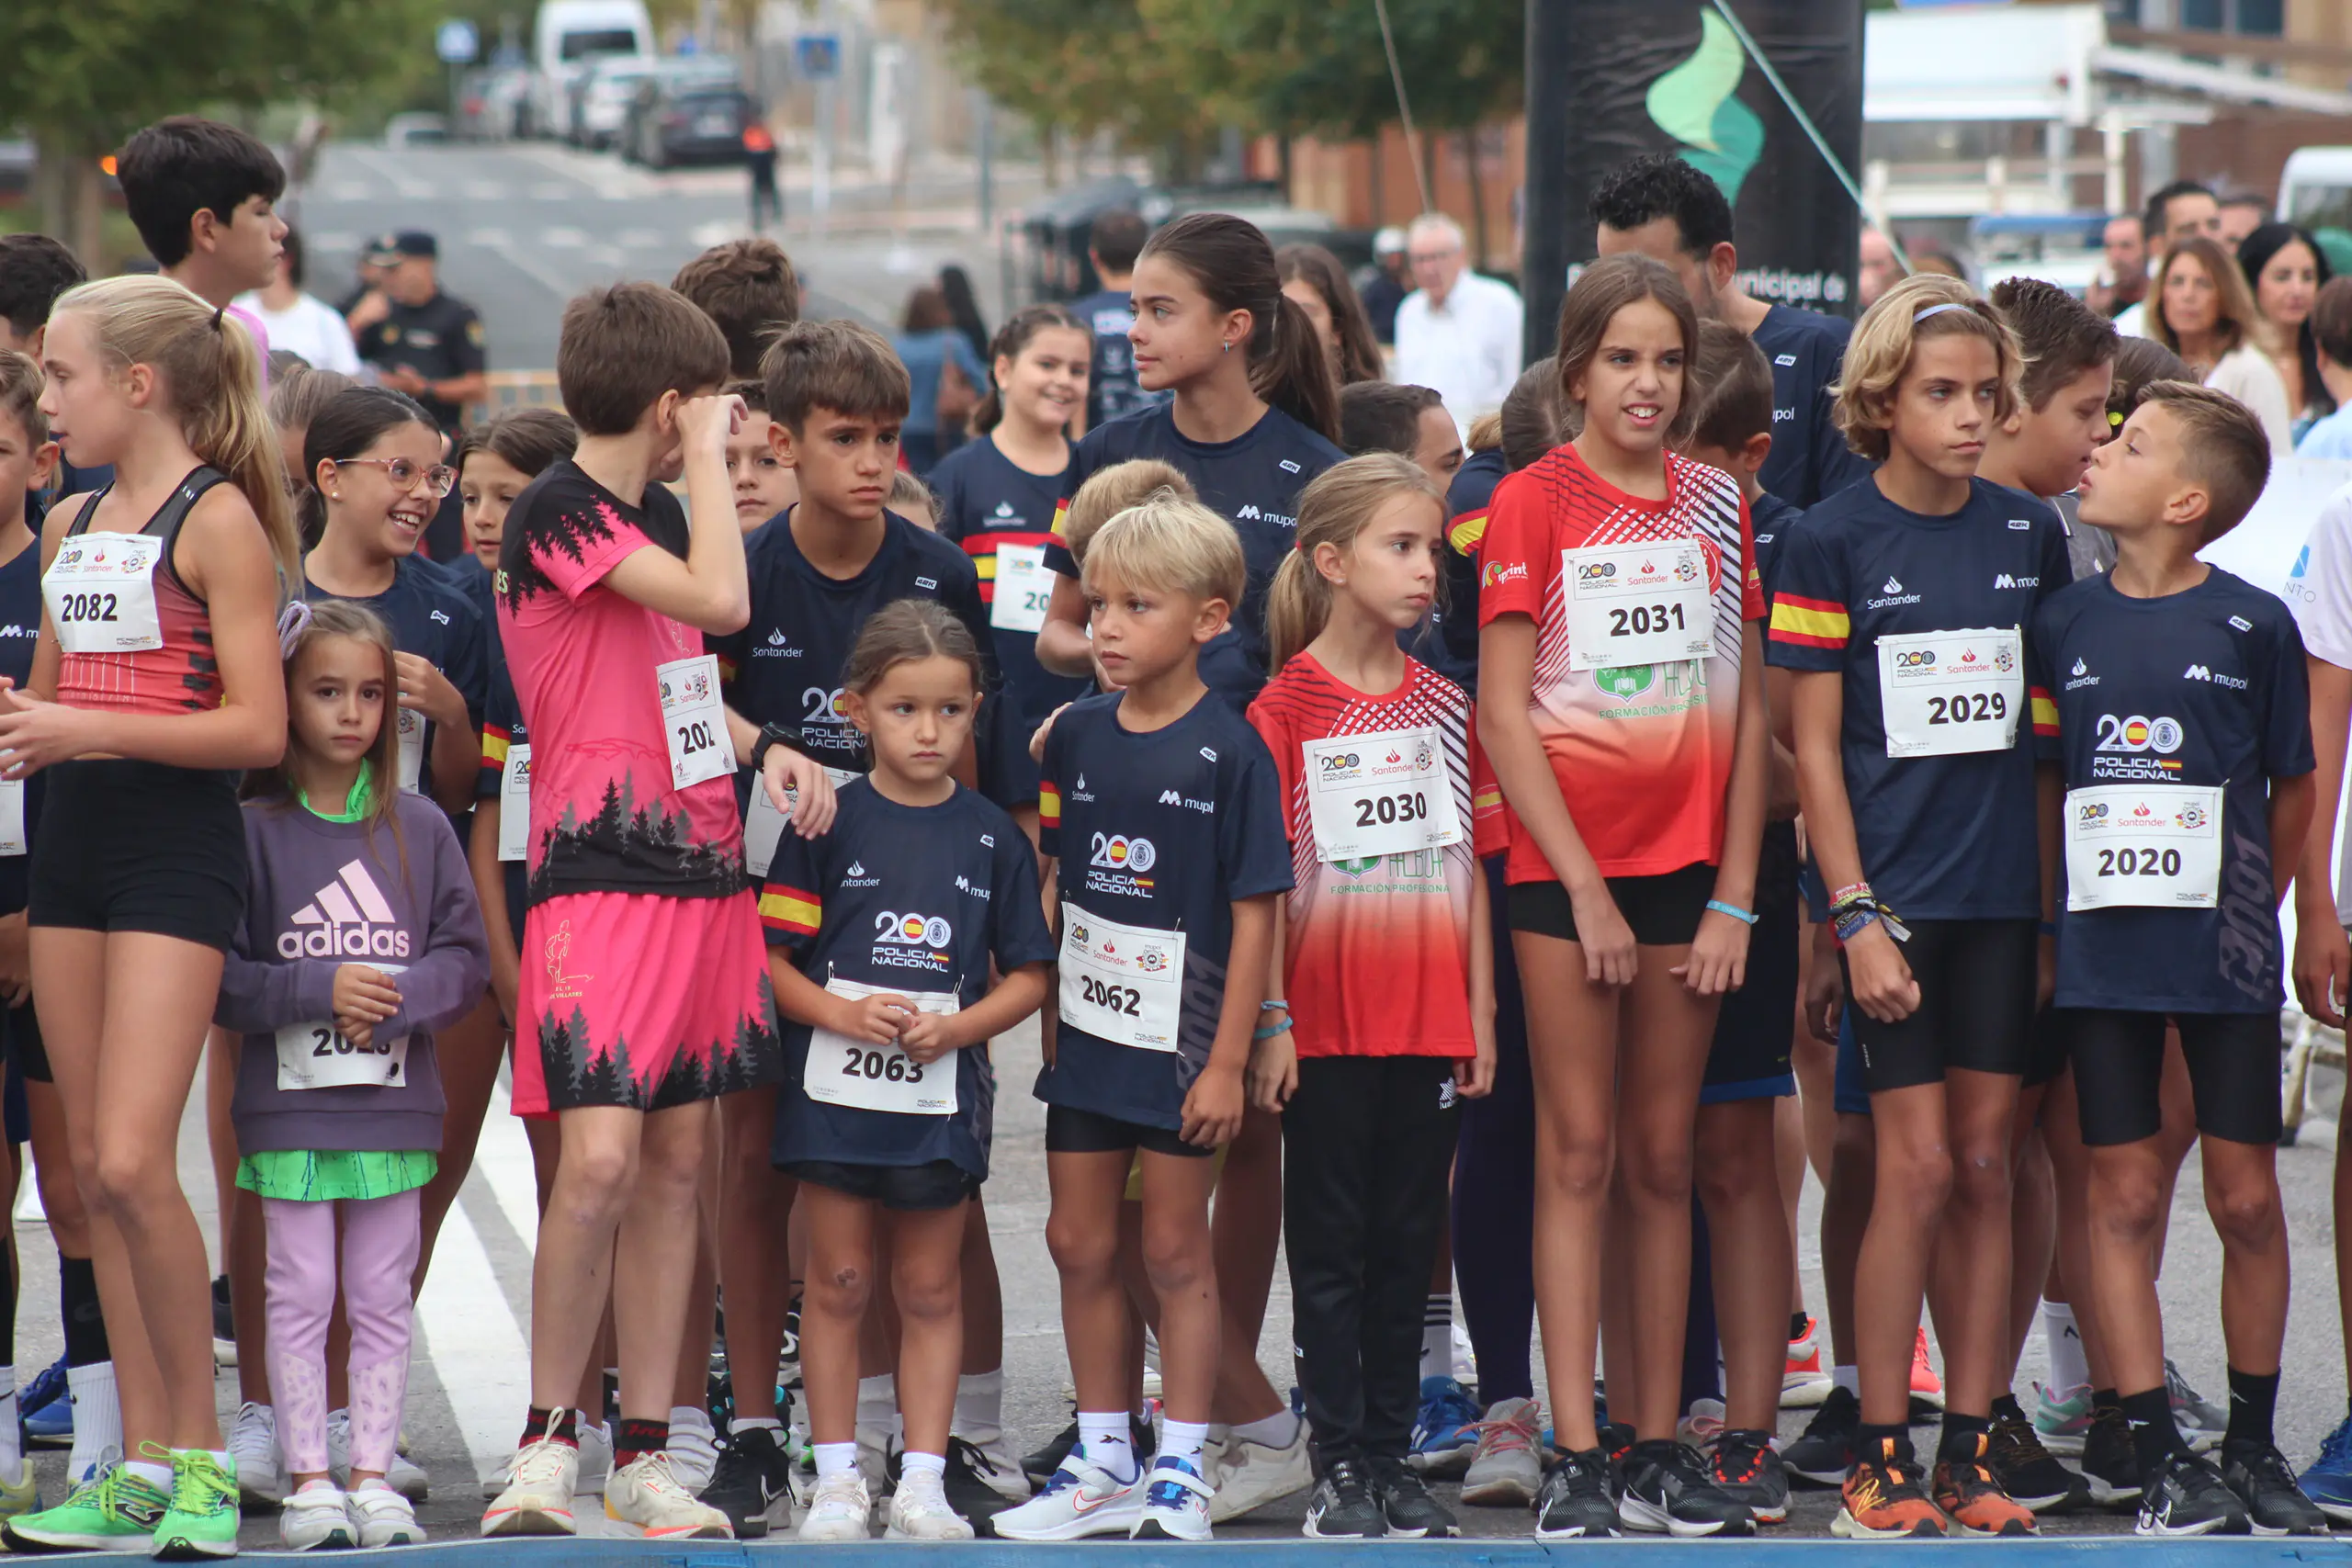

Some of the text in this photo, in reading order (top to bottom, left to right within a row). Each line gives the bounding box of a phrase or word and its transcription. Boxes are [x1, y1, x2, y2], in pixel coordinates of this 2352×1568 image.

[1733, 268, 1846, 301] unicipal de
[1264, 513, 1297, 527] mupo
[1578, 562, 1616, 580] 200
[497, 568, 508, 593] ES
[1627, 575, 1668, 586] Santander
[1023, 591, 1050, 611] 20
[1867, 593, 1921, 610] Santander
[2283, 581, 2316, 604] NTO
[62, 593, 118, 622] 2082
[1610, 603, 1685, 637] 2031
[752, 647, 803, 659] Santander
[1896, 650, 1936, 668] 200
[1947, 663, 1990, 674] Santander
[2064, 675, 2100, 691] antander
[1928, 692, 2007, 725] 2029
[2096, 714, 2184, 754] 200
[1321, 753, 1360, 771] 200
[1372, 764, 1413, 776] Santander
[2093, 756, 2163, 770] POLICIA
[2093, 768, 2181, 782] NACIONAL
[1353, 792, 1427, 828] 2030
[2080, 803, 2109, 821] 200
[2118, 818, 2166, 828] Santander
[1090, 831, 1156, 873] 200
[2098, 849, 2182, 877] 2020
[840, 877, 880, 888] ntander
[1088, 870, 1137, 886] POLICIA
[1085, 880, 1153, 898] NACIONAL
[875, 910, 952, 949] 200
[277, 921, 410, 959] adidas
[872, 946, 935, 961] POLICIA
[1092, 950, 1128, 966] Santander
[871, 956, 948, 973] NACIONAL
[1081, 975, 1140, 1018] 2062
[311, 1028, 391, 1057] 20
[842, 1047, 923, 1083] 2063
